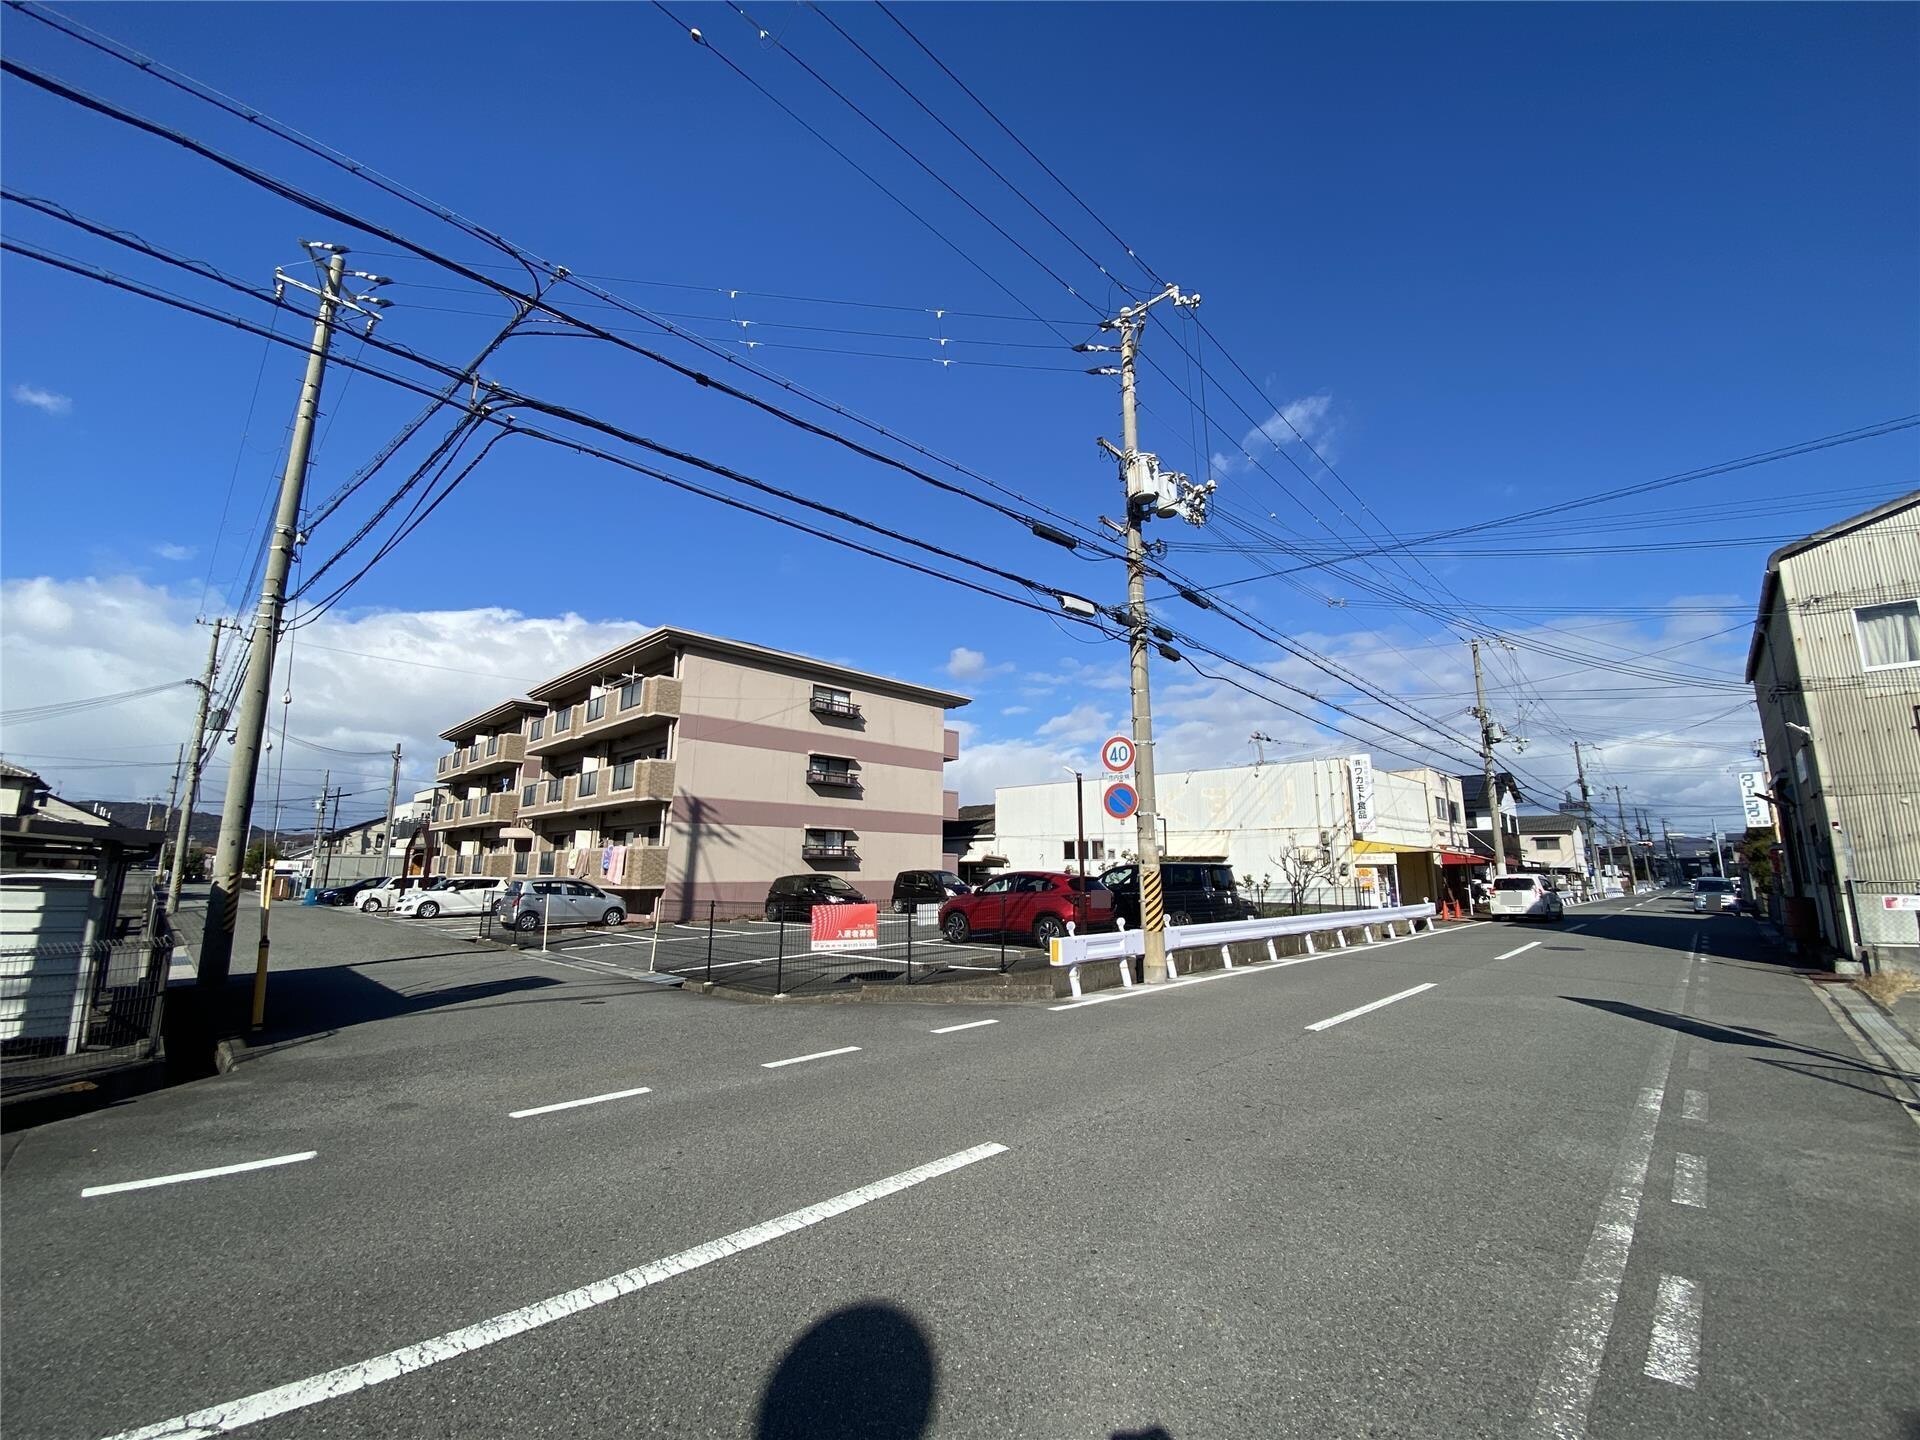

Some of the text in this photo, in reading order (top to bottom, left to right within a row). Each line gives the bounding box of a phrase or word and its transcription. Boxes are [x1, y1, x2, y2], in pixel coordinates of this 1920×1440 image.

[1110, 746, 1128, 762] 40
[1741, 773, 1760, 818] クリーニング
